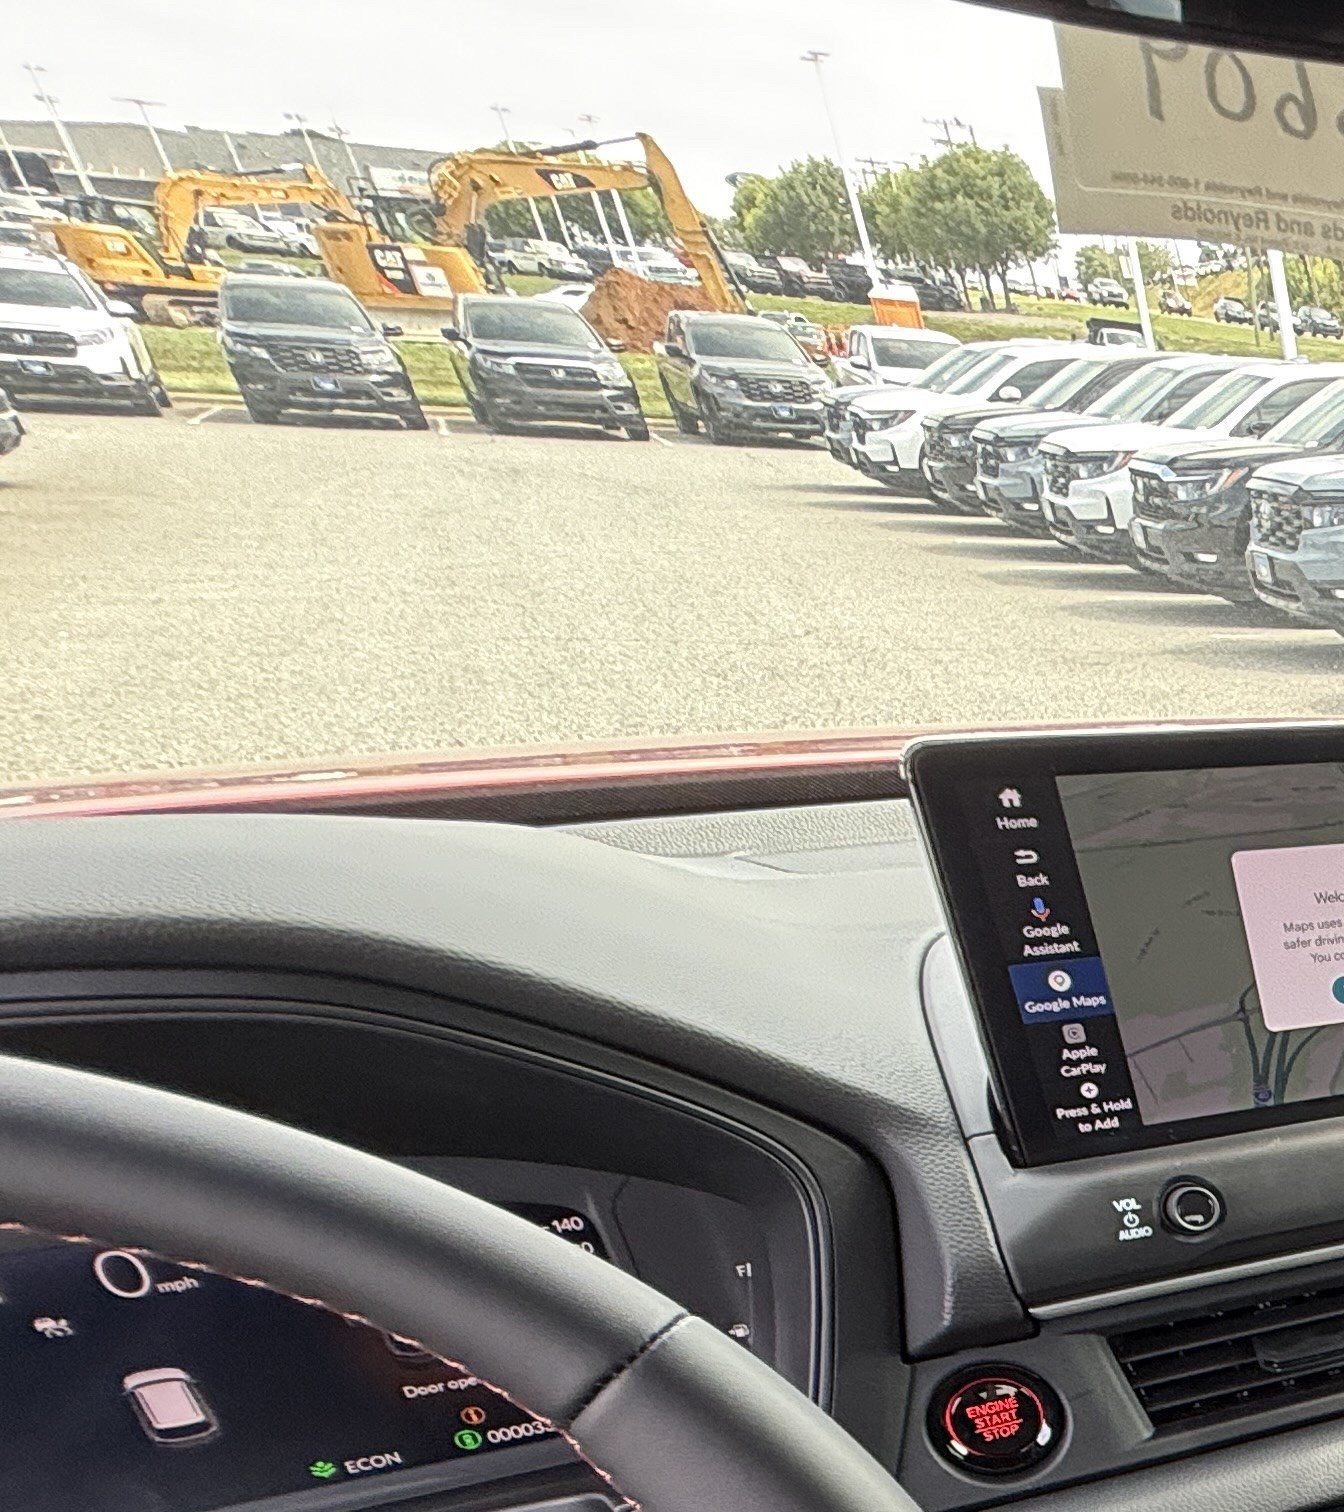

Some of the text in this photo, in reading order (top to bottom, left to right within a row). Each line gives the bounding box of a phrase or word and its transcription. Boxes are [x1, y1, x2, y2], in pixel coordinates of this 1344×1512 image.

[551, 172, 577, 190] CAT
[373, 250, 405, 269] CAT
[995, 816, 1039, 830] Home
[1016, 873, 1050, 888] Back
[1023, 922, 1070, 939] Google
[1283, 920, 1315, 934] Maps
[1317, 917, 1343, 930] uses
[1022, 940, 1082, 957] Assistant
[1283, 937, 1312, 950] safer
[1310, 952, 1333, 965] You
[1024, 994, 1107, 1014] Google Maps
[1061, 1045, 1099, 1061] Apple
[1060, 1062, 1107, 1078] CarPlay
[1055, 1097, 1133, 1120] Press & Hold
[1078, 1116, 1120, 1134] to Add
[1112, 1197, 1142, 1212] VOL
[551, 1215, 585, 1234] 140
[1118, 1225, 1154, 1242] AUDIO
[156, 1275, 199, 1293] mph
[402, 1376, 480, 1399] Door ope
[965, 1396, 1019, 1419] ENGINE
[974, 1409, 1018, 1430] START
[982, 1424, 1020, 1442] STOP
[344, 1452, 404, 1475] ECON
